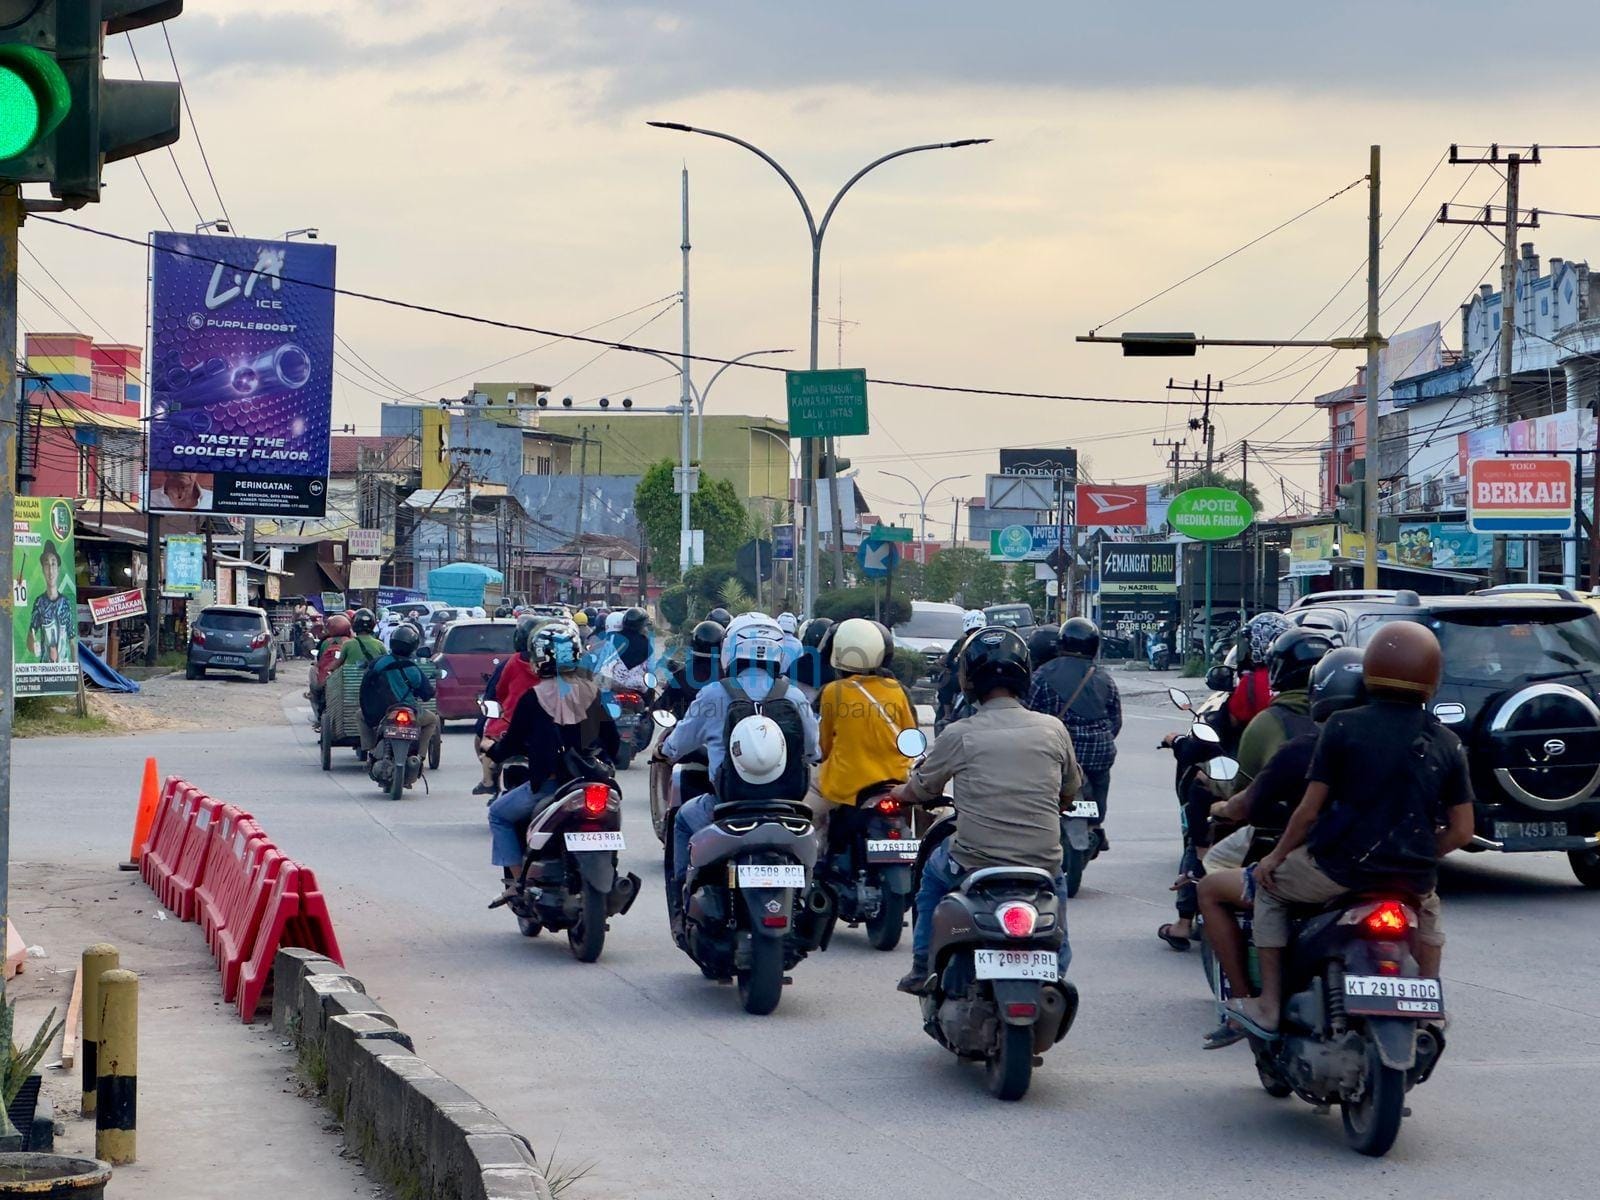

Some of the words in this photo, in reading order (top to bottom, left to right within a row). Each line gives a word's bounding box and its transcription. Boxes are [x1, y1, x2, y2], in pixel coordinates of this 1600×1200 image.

[256, 299, 283, 310] ICE
[792, 396, 832, 407] KAWASAN
[802, 409, 823, 419] LALU
[826, 407, 853, 418] LINTAS
[199, 434, 249, 446] TASTE
[254, 437, 286, 448] THE
[173, 445, 247, 458] COOLEST
[251, 449, 309, 461] FLAVOR
[1510, 462, 1537, 471] TOKO
[235, 480, 293, 491] PERINGATAN:
[1477, 482, 1567, 504] BERKAH
[1192, 499, 1238, 512] APOTEK
[1176, 514, 1210, 526] MEDIKA
[1213, 514, 1244, 526] FARMA
[1032, 527, 1056, 540] APOTEK
[1151, 554, 1174, 573] BARU
[1118, 584, 1127, 592] by
[14, 587, 27, 602] 10
[1116, 622, 1139, 631] SPARE
[1520, 822, 1547, 837] 1493
[604, 833, 622, 841] RBA
[739, 867, 752, 877] KT
[978, 953, 994, 964] KT
[998, 953, 1030, 966] 2089
[1033, 954, 1056, 966] RBL
[1022, 969, 1056, 979] 01-28
[1349, 981, 1365, 994] KT
[1371, 982, 1405, 996] 2919
[1411, 985, 1436, 998] RDG
[1399, 1002, 1437, 1011] 11-28
